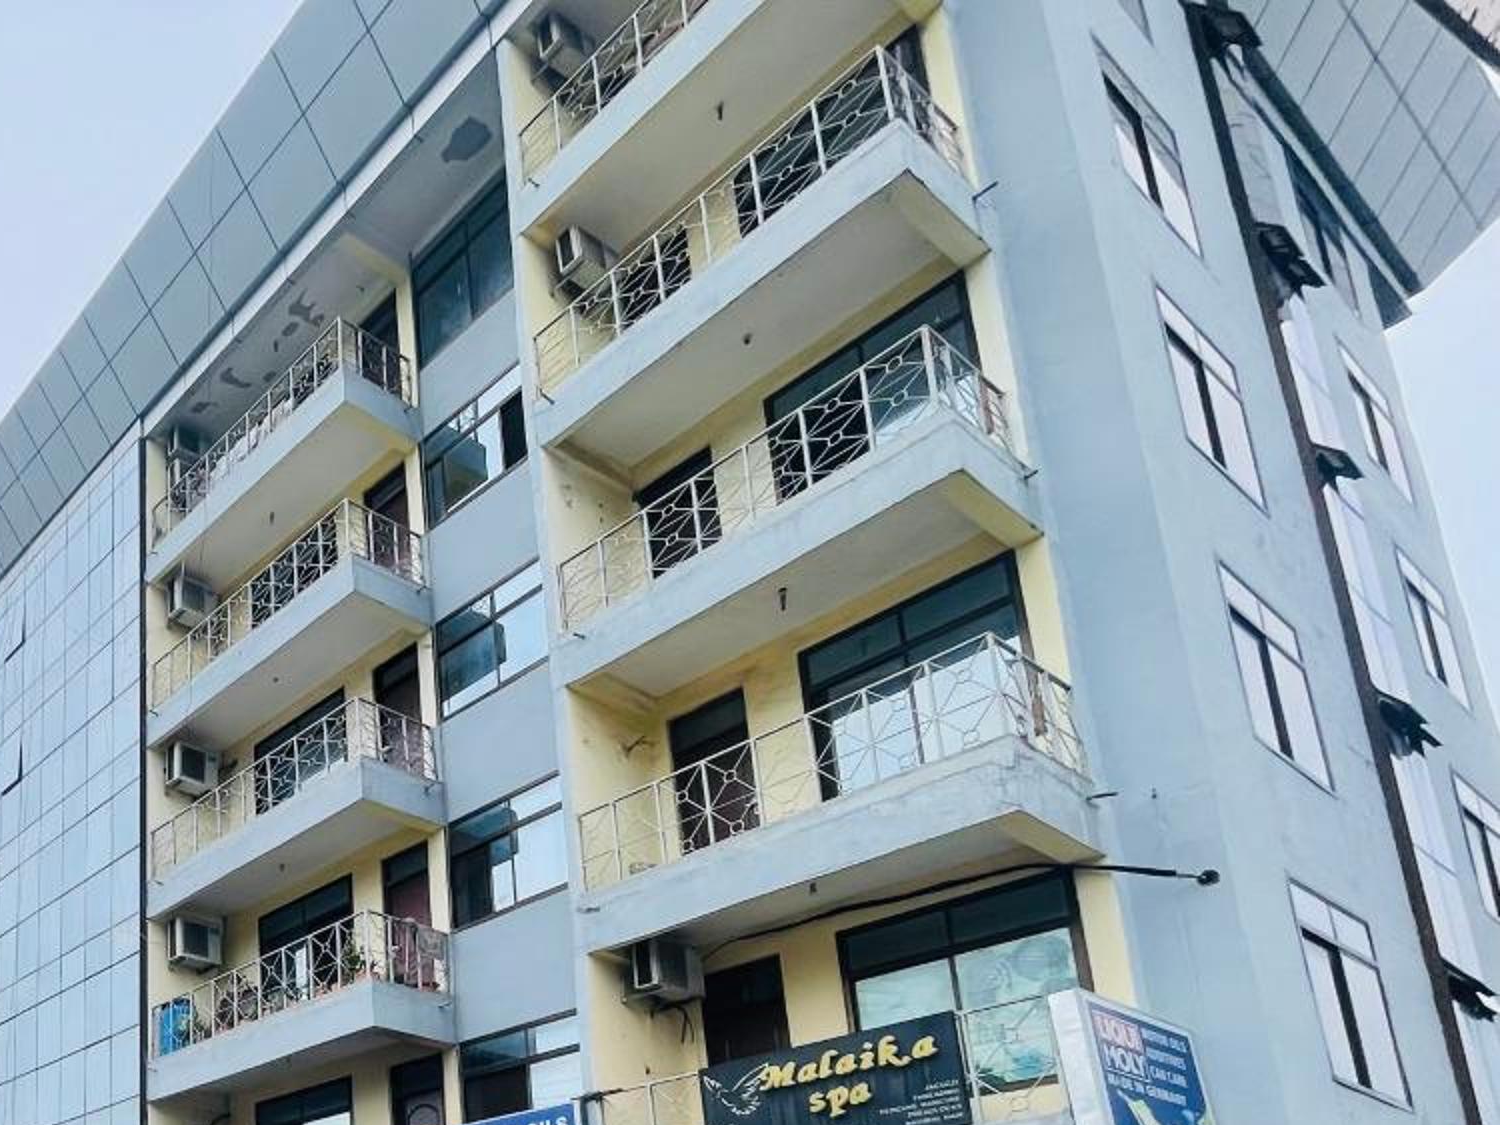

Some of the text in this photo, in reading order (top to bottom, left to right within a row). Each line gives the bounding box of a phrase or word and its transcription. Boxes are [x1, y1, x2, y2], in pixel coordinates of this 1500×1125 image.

[1094, 1015, 1142, 1053] LIQUI
[759, 1035, 939, 1091] Malaika
[1104, 1043, 1145, 1076] MOLY
[809, 1082, 872, 1118] spa
